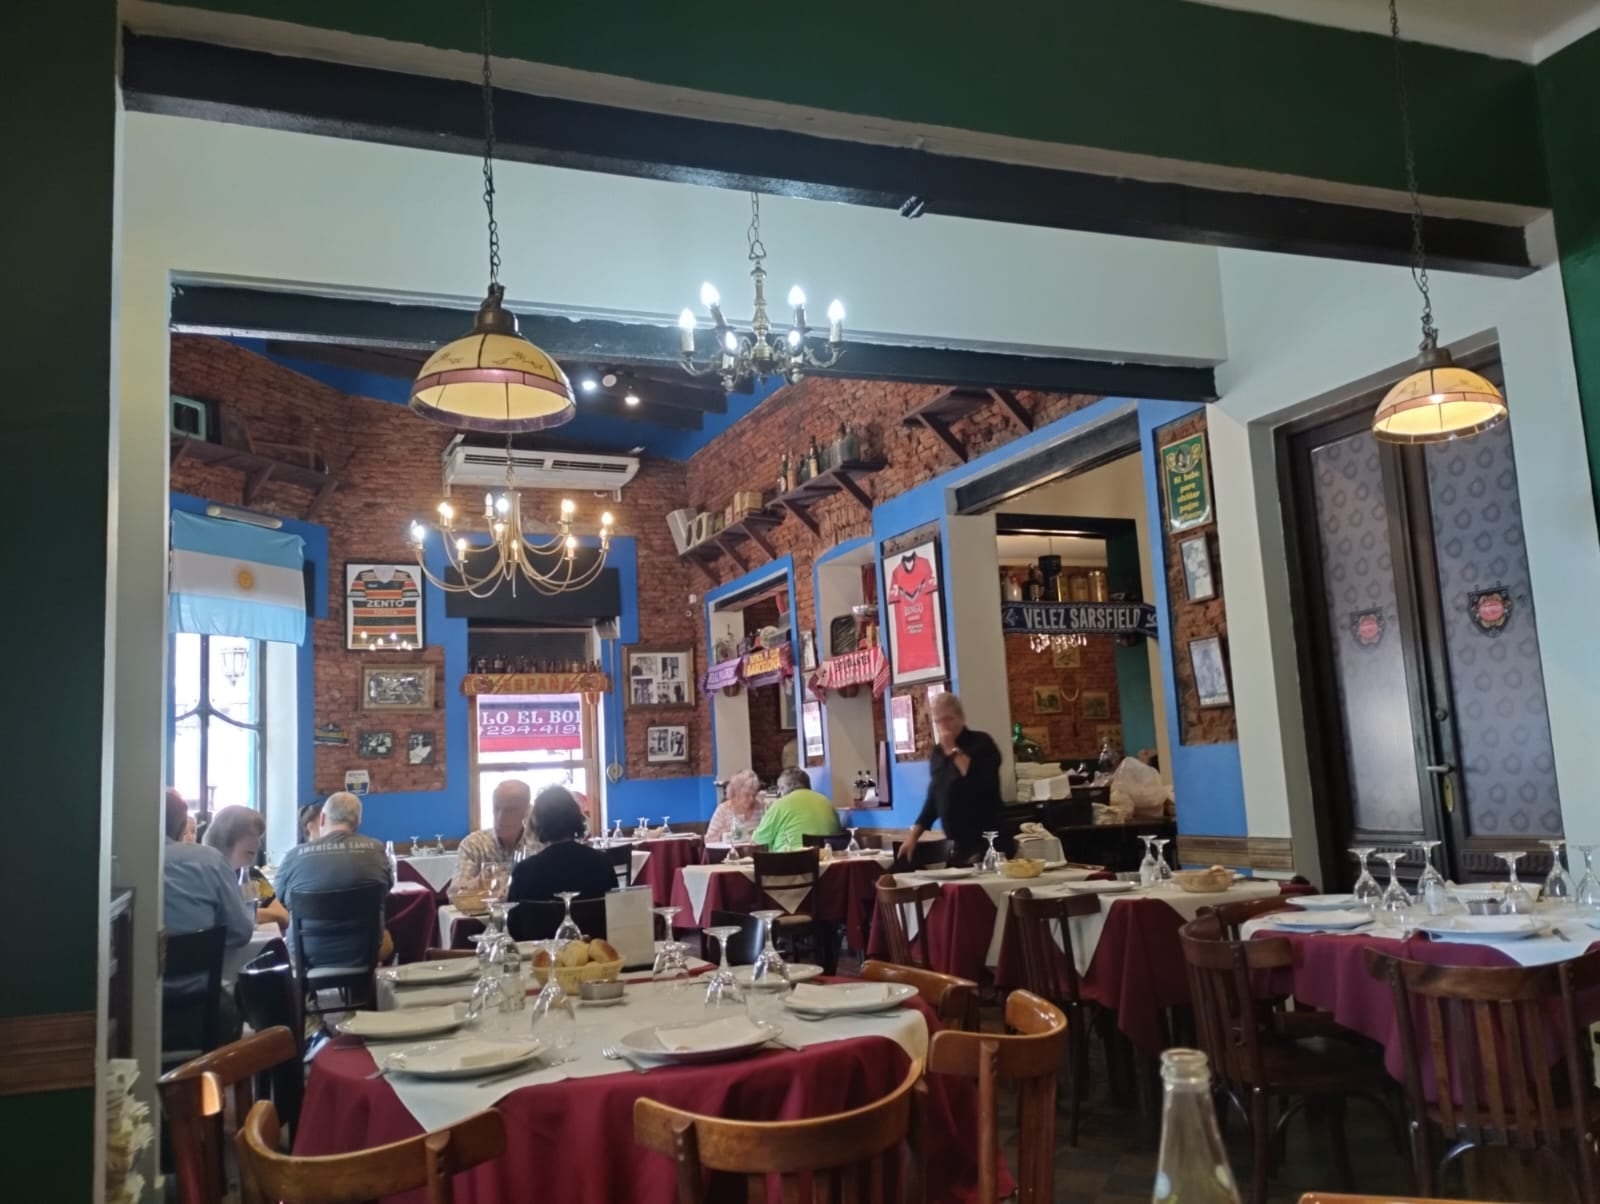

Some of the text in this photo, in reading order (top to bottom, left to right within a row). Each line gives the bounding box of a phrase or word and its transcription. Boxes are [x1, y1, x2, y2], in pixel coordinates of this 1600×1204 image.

[366, 599, 405, 608] ZENTO
[1022, 607, 1067, 629] VELEZ
[1070, 607, 1141, 629] SARSFIELD
[517, 710, 543, 724] EL
